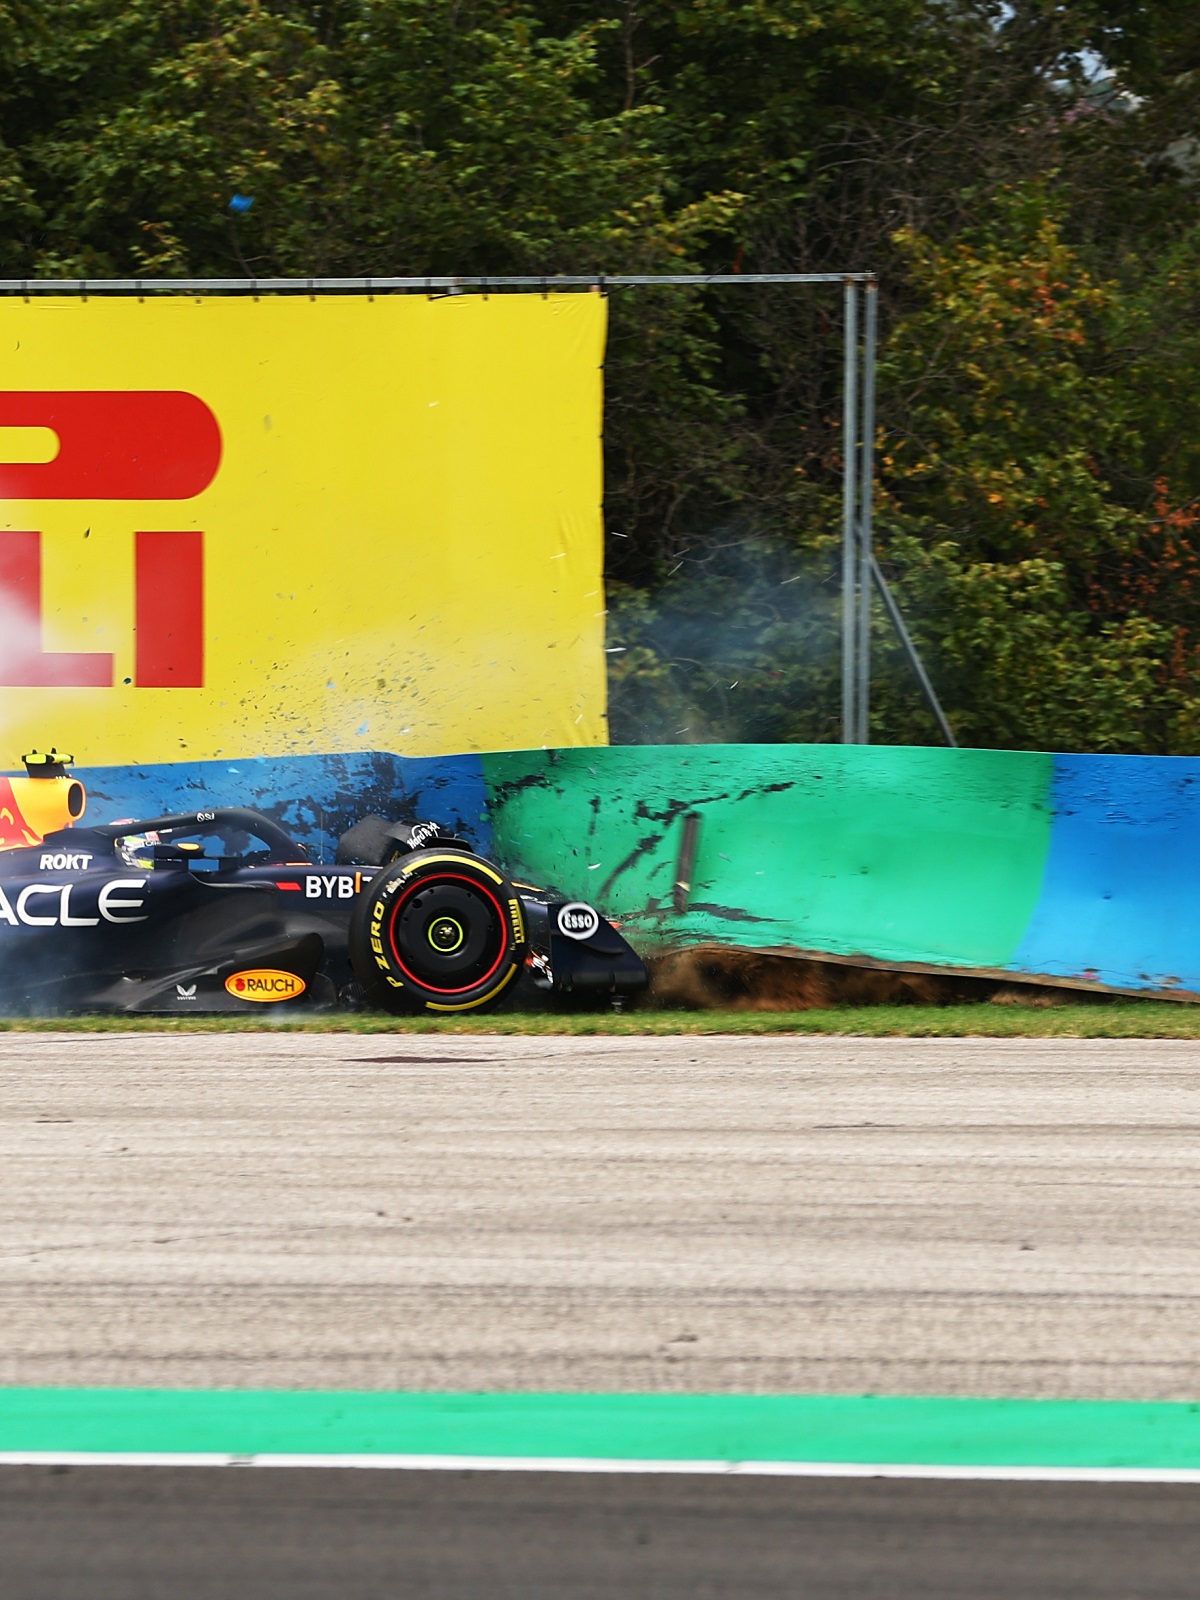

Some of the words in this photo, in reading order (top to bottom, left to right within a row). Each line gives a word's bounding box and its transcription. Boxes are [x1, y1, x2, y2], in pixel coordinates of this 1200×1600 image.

[39, 854, 93, 870] ROKT
[306, 871, 373, 898] BYBI
[370, 901, 391, 970] ZERO
[247, 979, 294, 992] RAUCH
